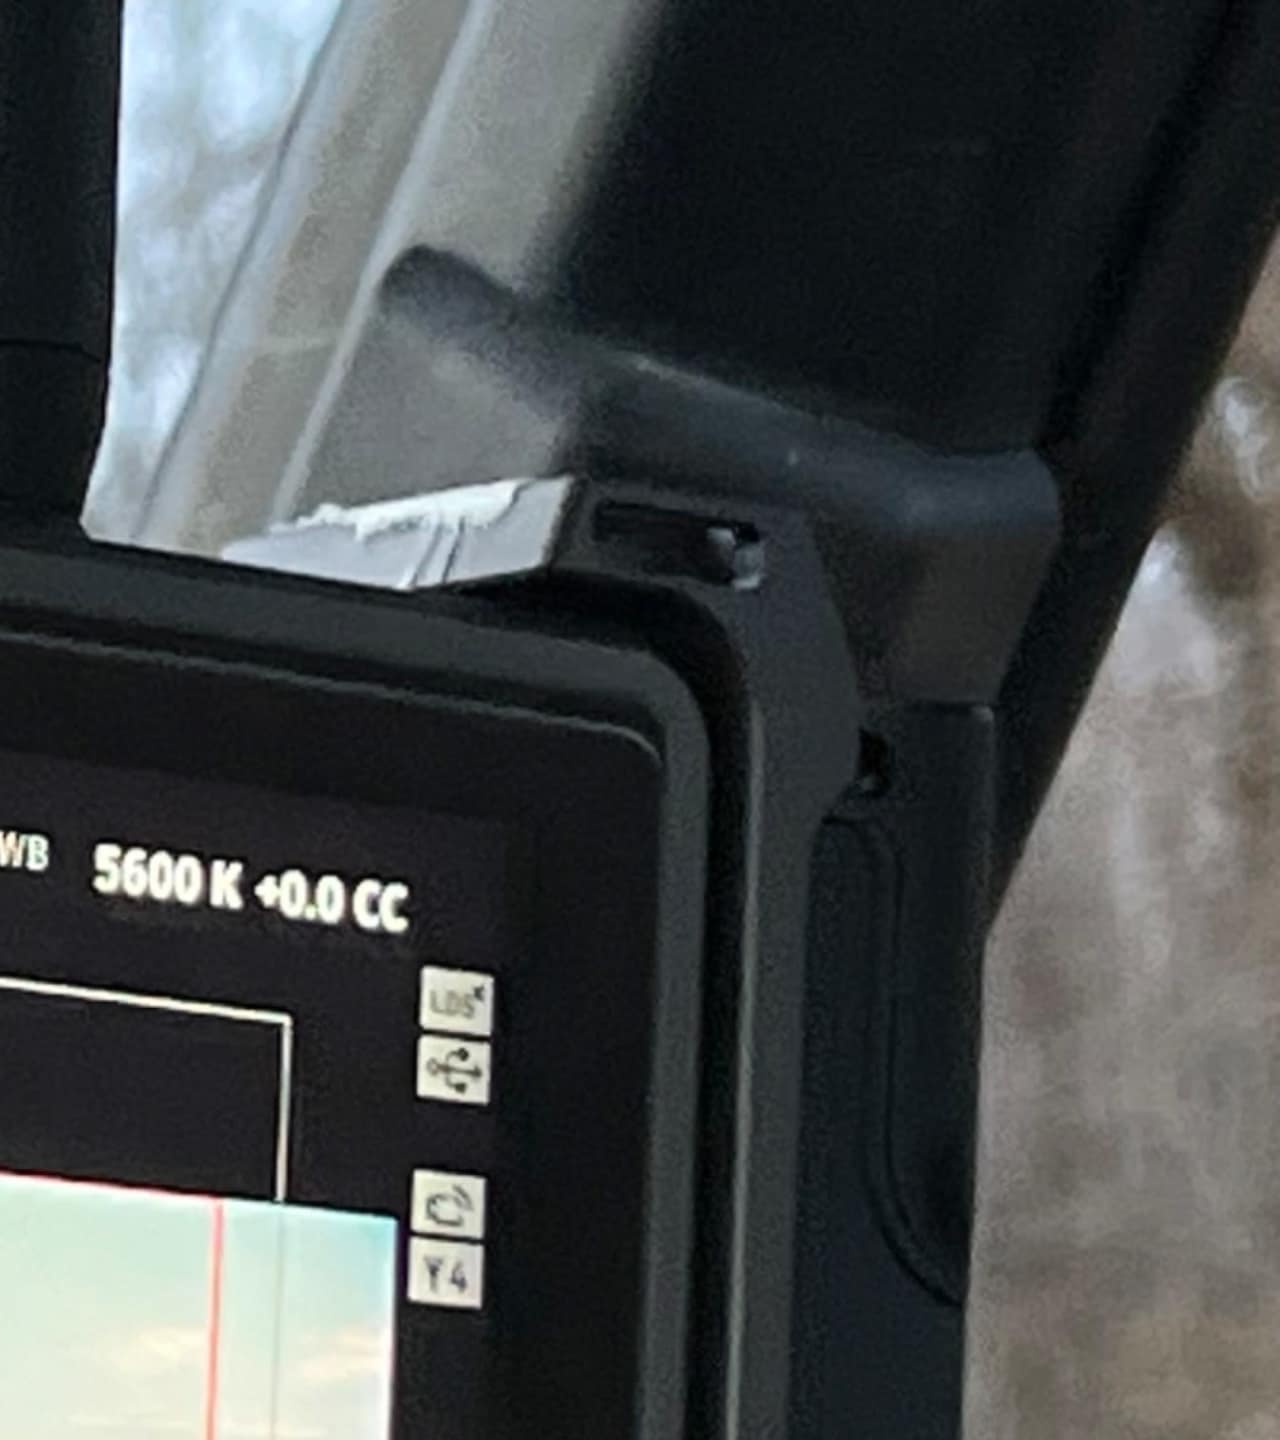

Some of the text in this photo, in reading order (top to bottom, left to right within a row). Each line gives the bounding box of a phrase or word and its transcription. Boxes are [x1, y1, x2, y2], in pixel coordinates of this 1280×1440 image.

[93, 843, 203, 904] 5600
[209, 860, 244, 910] K
[254, 868, 346, 923] +0.0
[352, 878, 410, 933] CC
